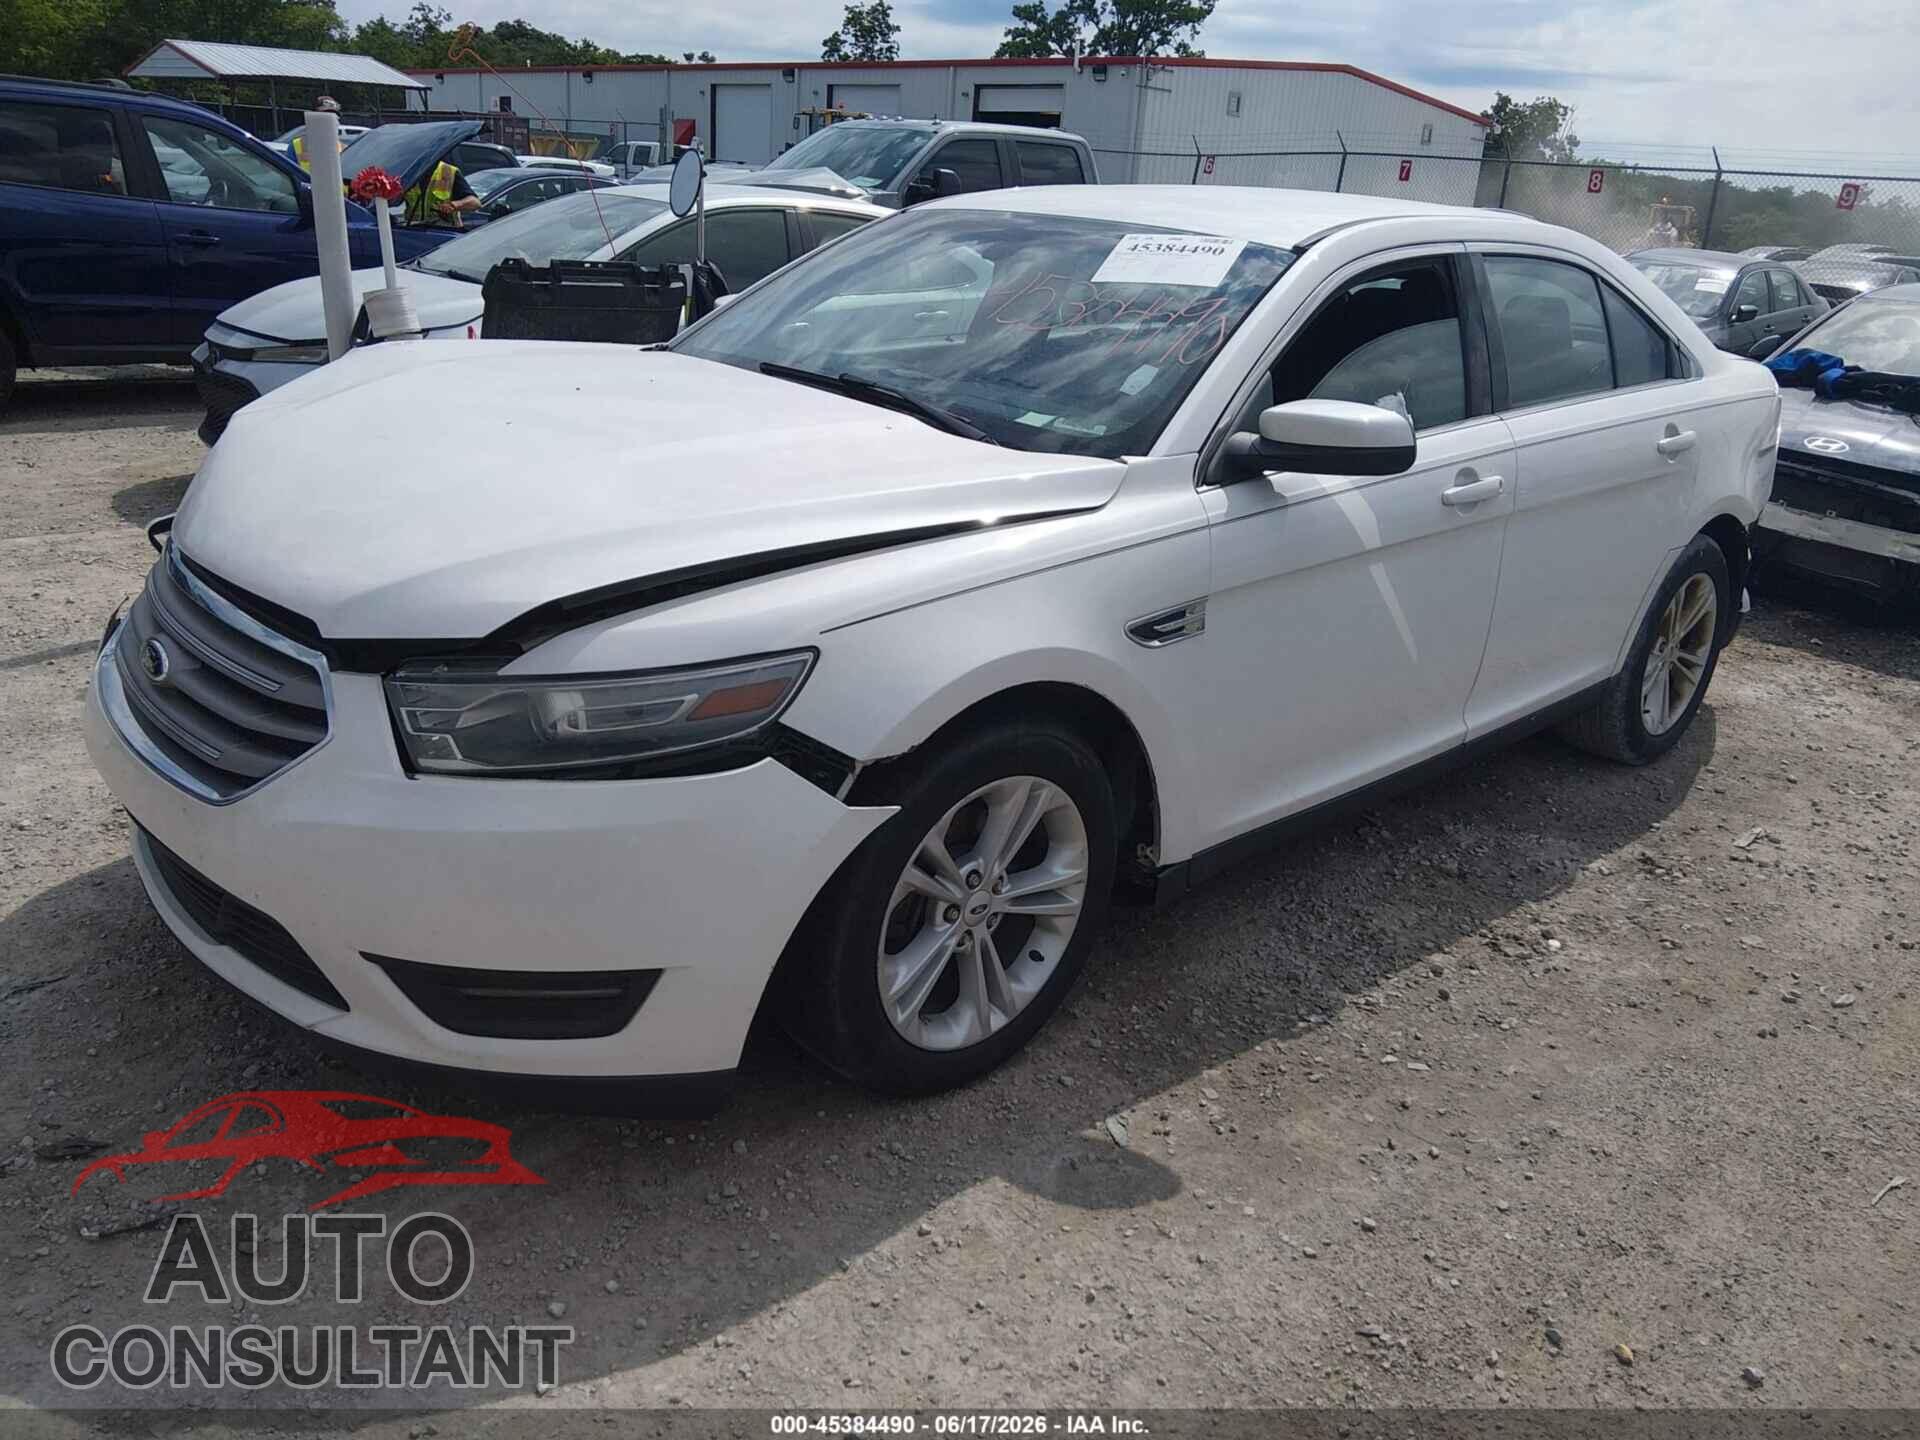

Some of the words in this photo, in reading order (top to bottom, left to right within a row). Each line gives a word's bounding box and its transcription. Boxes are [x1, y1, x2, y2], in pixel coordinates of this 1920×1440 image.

[1205, 157, 1213, 173] 6
[1401, 162, 1410, 179] 7
[1590, 172, 1601, 190] 8
[1840, 187, 1855, 206] 9
[1127, 242, 1226, 256] 45384490
